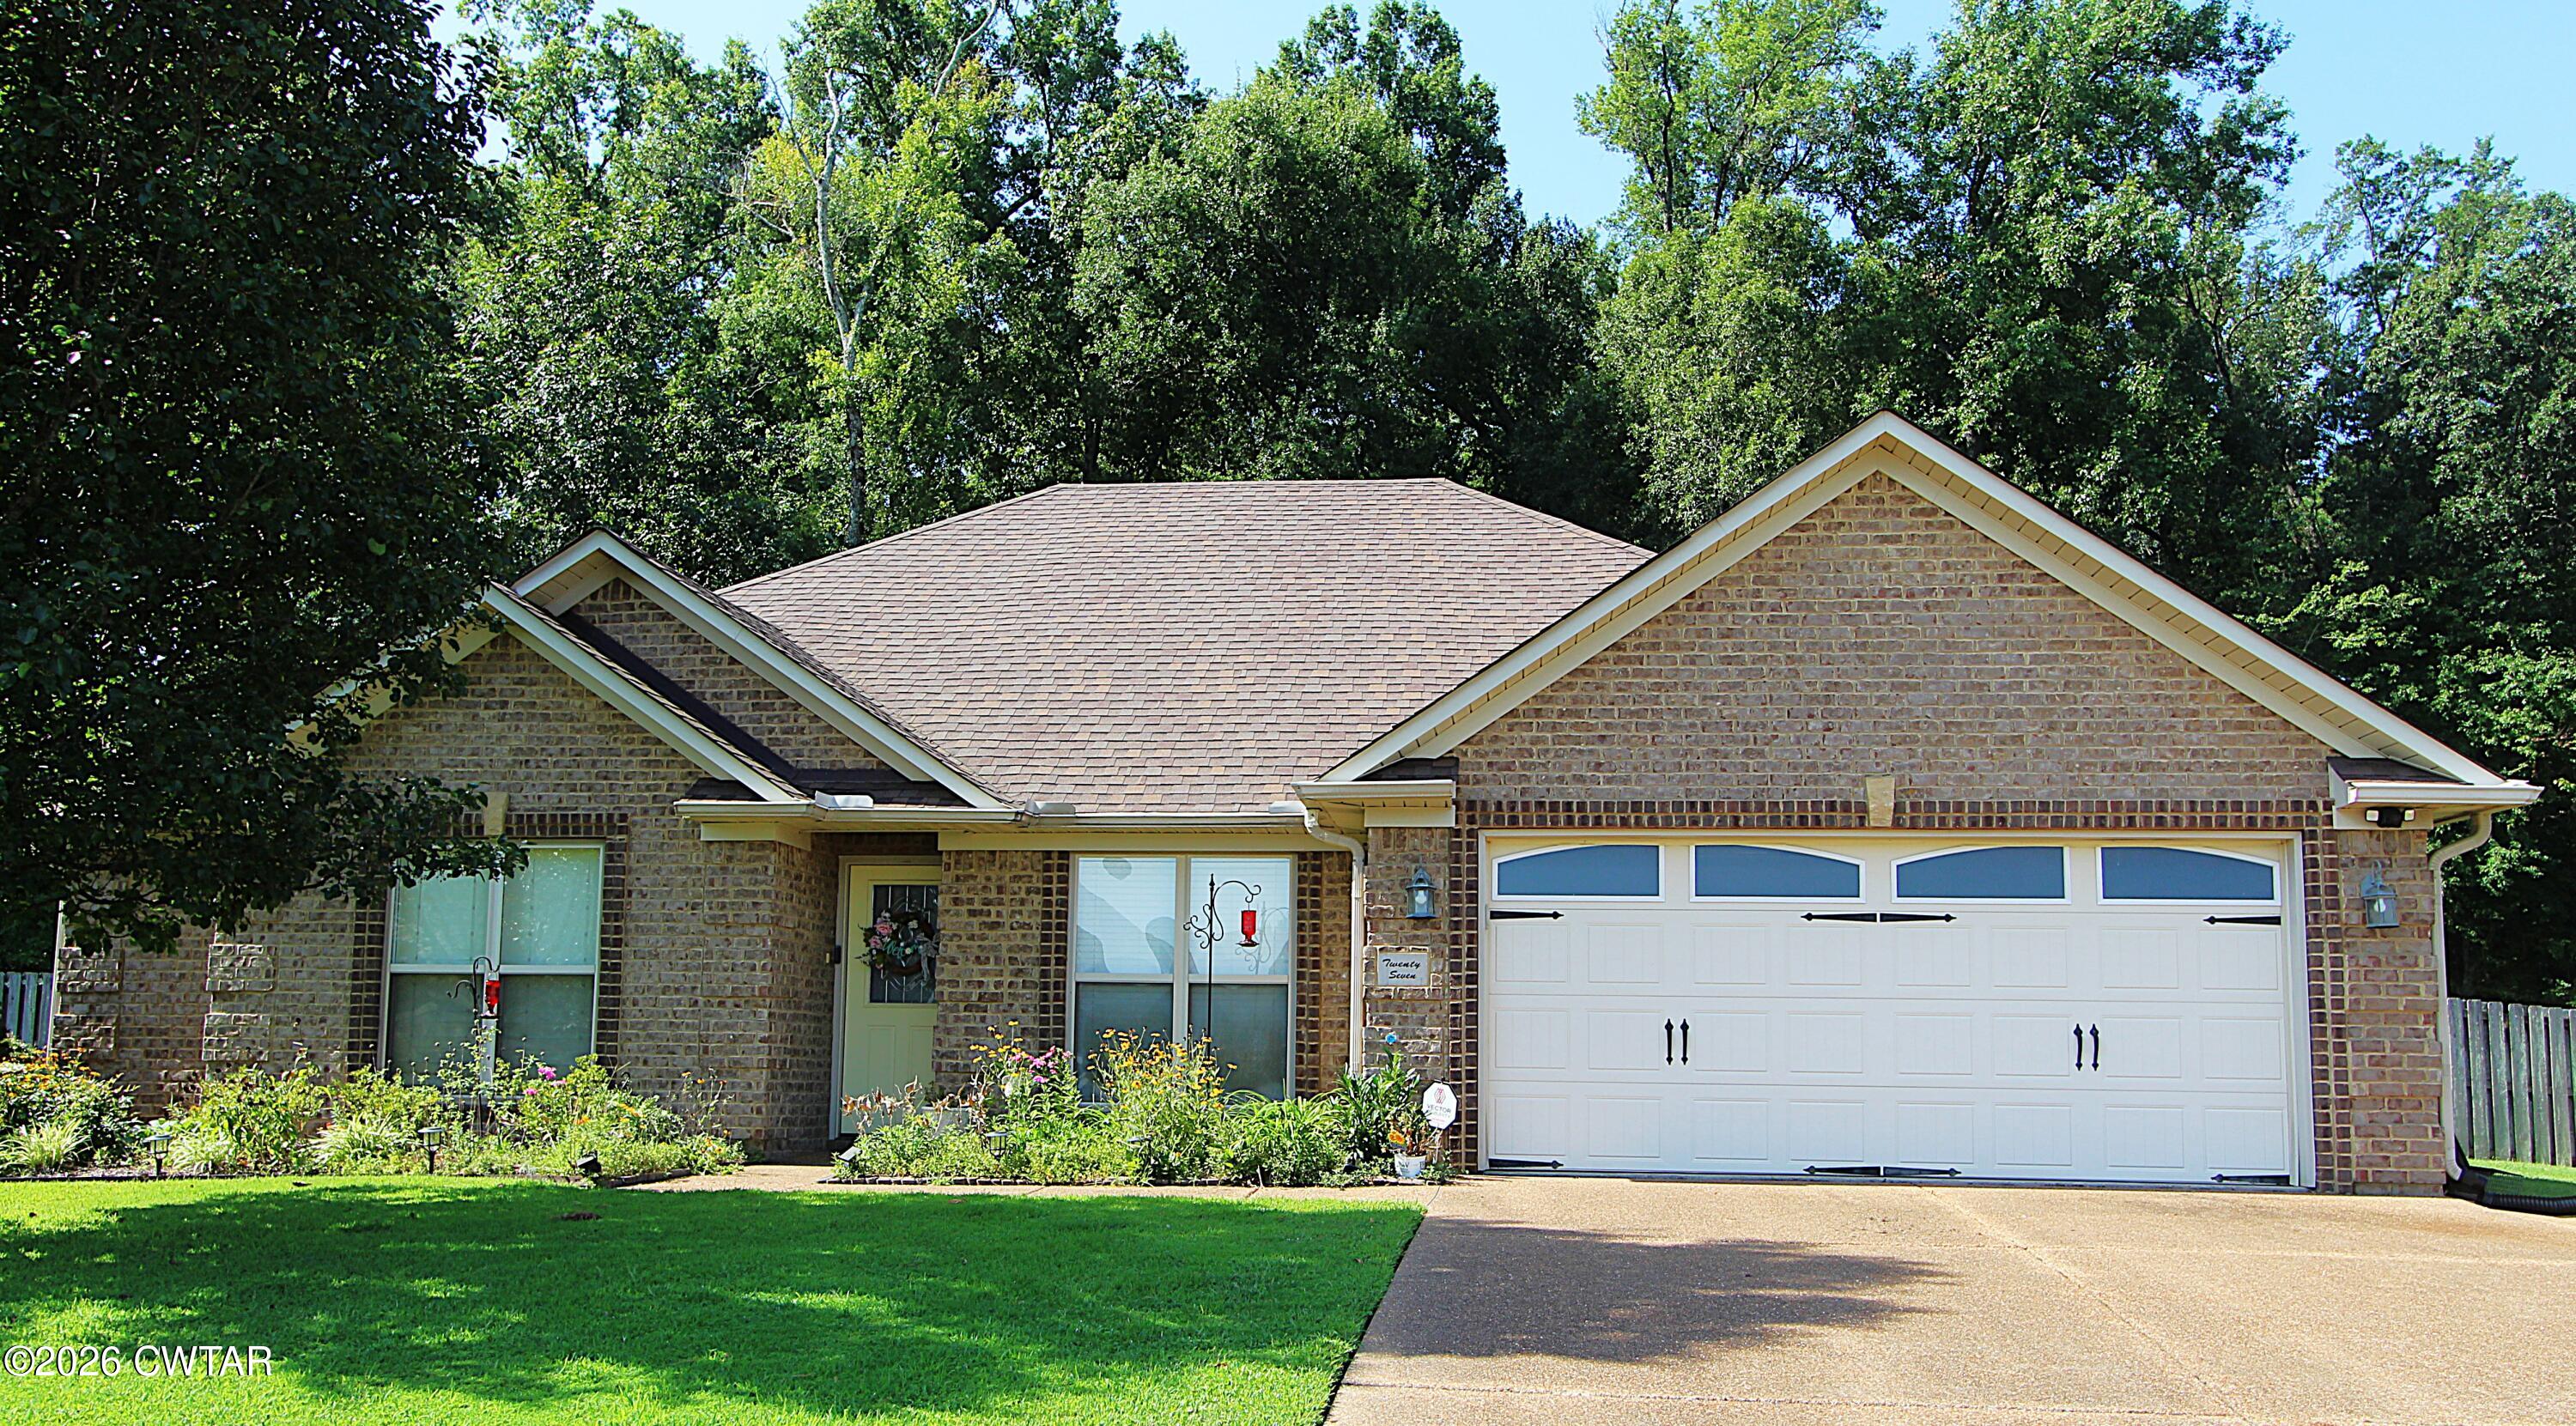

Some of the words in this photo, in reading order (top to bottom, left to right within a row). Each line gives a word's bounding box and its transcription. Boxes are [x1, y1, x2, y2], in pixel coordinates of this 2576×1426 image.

[1382, 958, 1420, 969] Twenty
[1388, 970, 1416, 980] Seven
[1427, 1104, 1451, 1113] VECTOR
